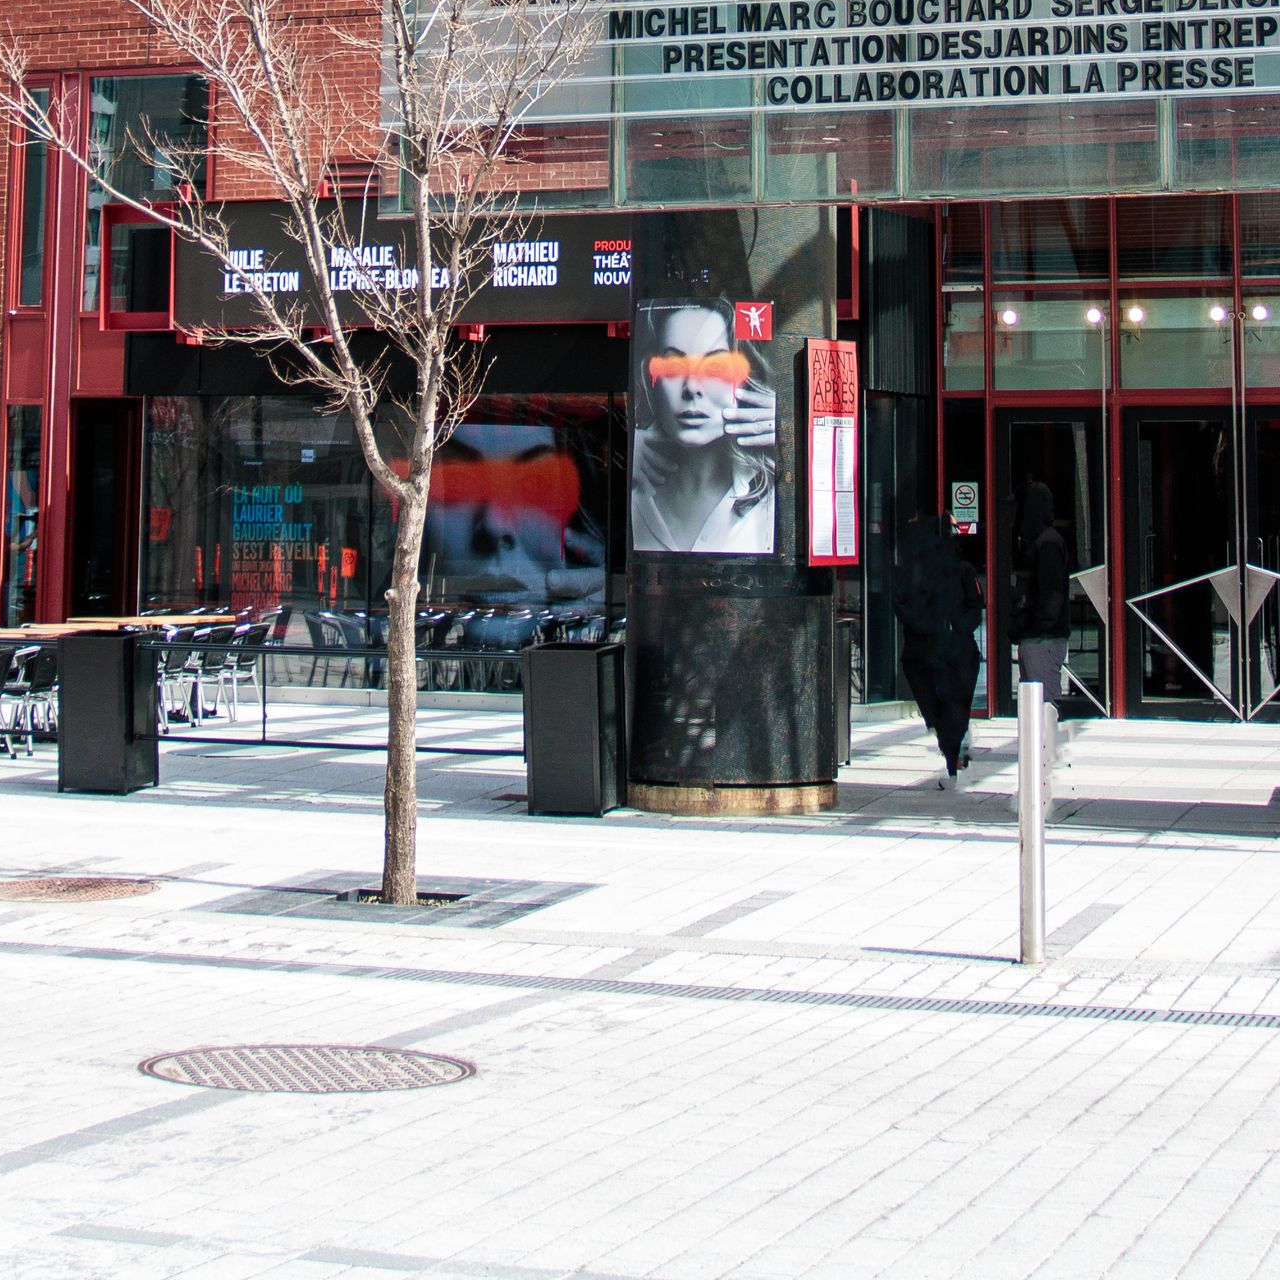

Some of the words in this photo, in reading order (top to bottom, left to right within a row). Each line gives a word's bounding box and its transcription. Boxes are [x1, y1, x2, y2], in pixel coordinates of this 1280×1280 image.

[609, 5, 727, 40] MICHEL
[737, 0, 836, 32] MARC
[663, 33, 907, 74] PRESENTATION
[917, 22, 1129, 63] DESJARDINS
[768, 64, 1051, 105] COLLABORATION
[1062, 62, 1106, 95] LA
[1119, 56, 1255, 92] PRESSE
[493, 241, 558, 263] MATHIEU
[594, 240, 631, 251] PRODU
[225, 250, 264, 270] JULIE
[331, 246, 393, 268] MAGALIE
[224, 273, 241, 293] LE
[244, 271, 300, 293] BRETON
[493, 266, 557, 287] RICHARD
[594, 271, 631, 285] NOUV
[813, 349, 853, 372] AVANT
[813, 368, 854, 383] PENDANT
[233, 485, 248, 503] LA
[251, 485, 281, 504] NUIT
[233, 504, 284, 522] LAURIER
[232, 523, 313, 541] GAUDREAULT
[232, 573, 261, 592] MICHEL
